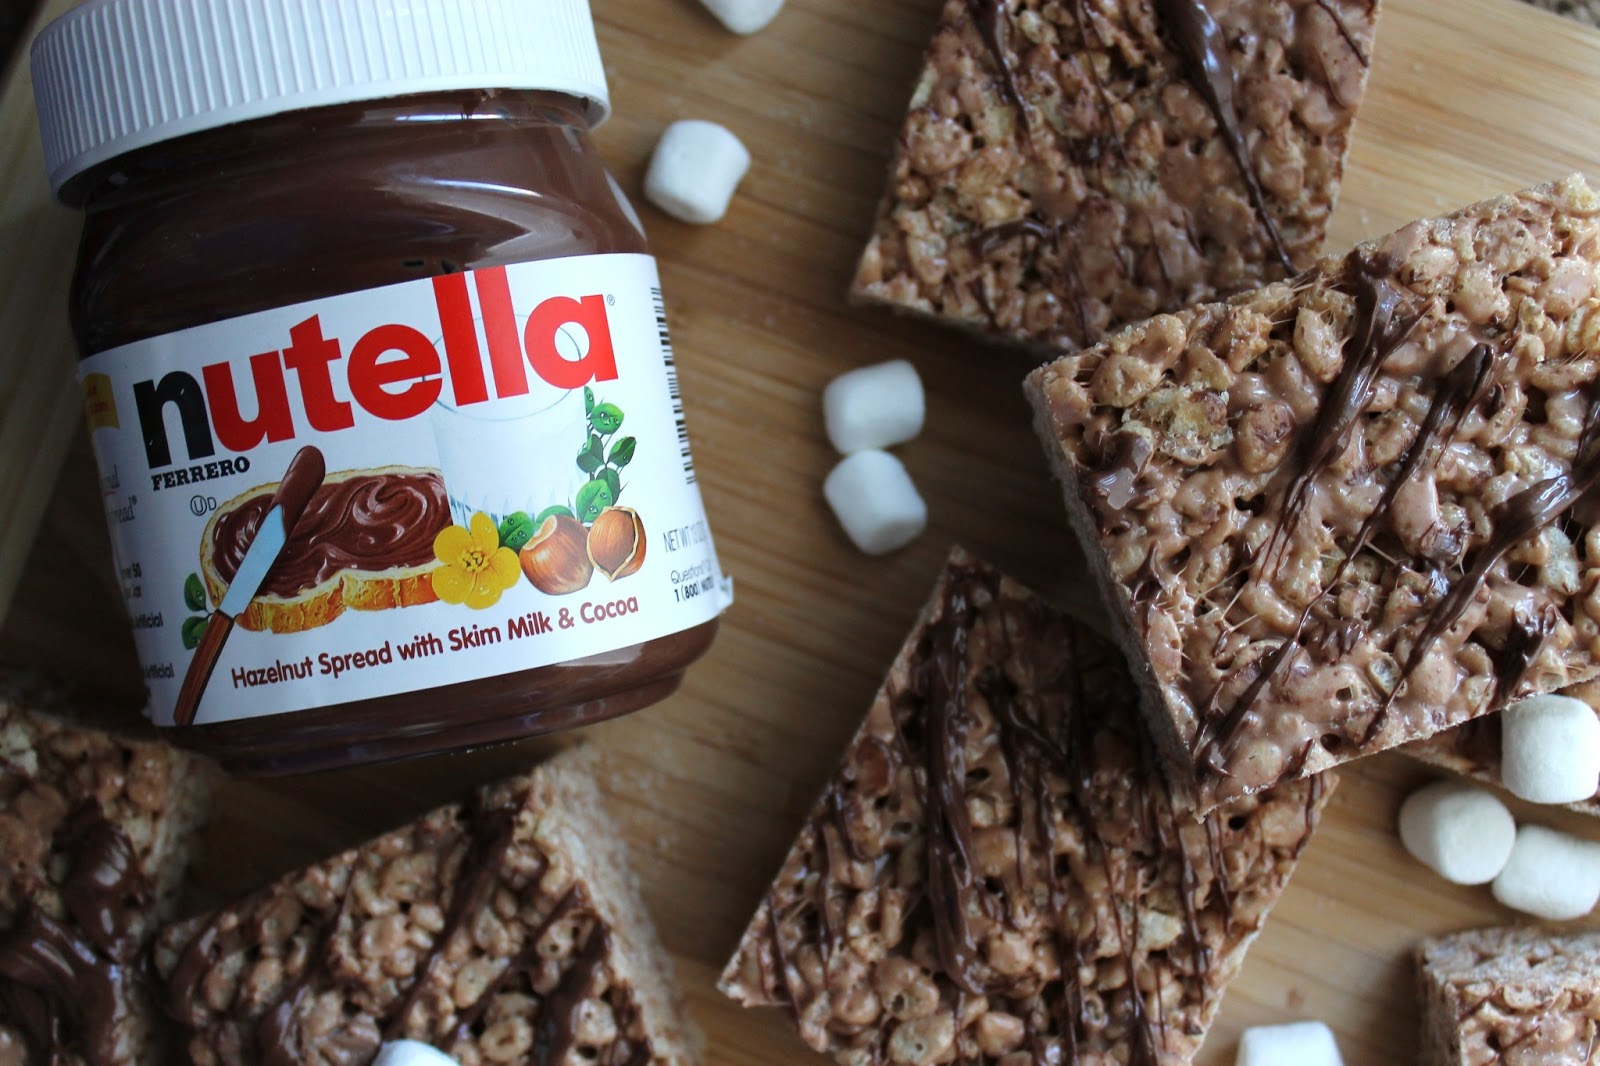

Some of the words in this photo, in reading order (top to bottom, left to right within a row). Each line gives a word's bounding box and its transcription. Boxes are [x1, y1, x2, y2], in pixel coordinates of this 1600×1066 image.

[151, 456, 251, 491] FERRERO
[663, 529, 680, 552] NET
[231, 656, 314, 689] Hazelnut
[318, 640, 393, 679] Spread
[397, 632, 444, 661] with
[448, 624, 502, 652] Skim
[507, 611, 553, 640] Milk
[558, 607, 575, 629] &
[580, 596, 639, 624] Cocoa
